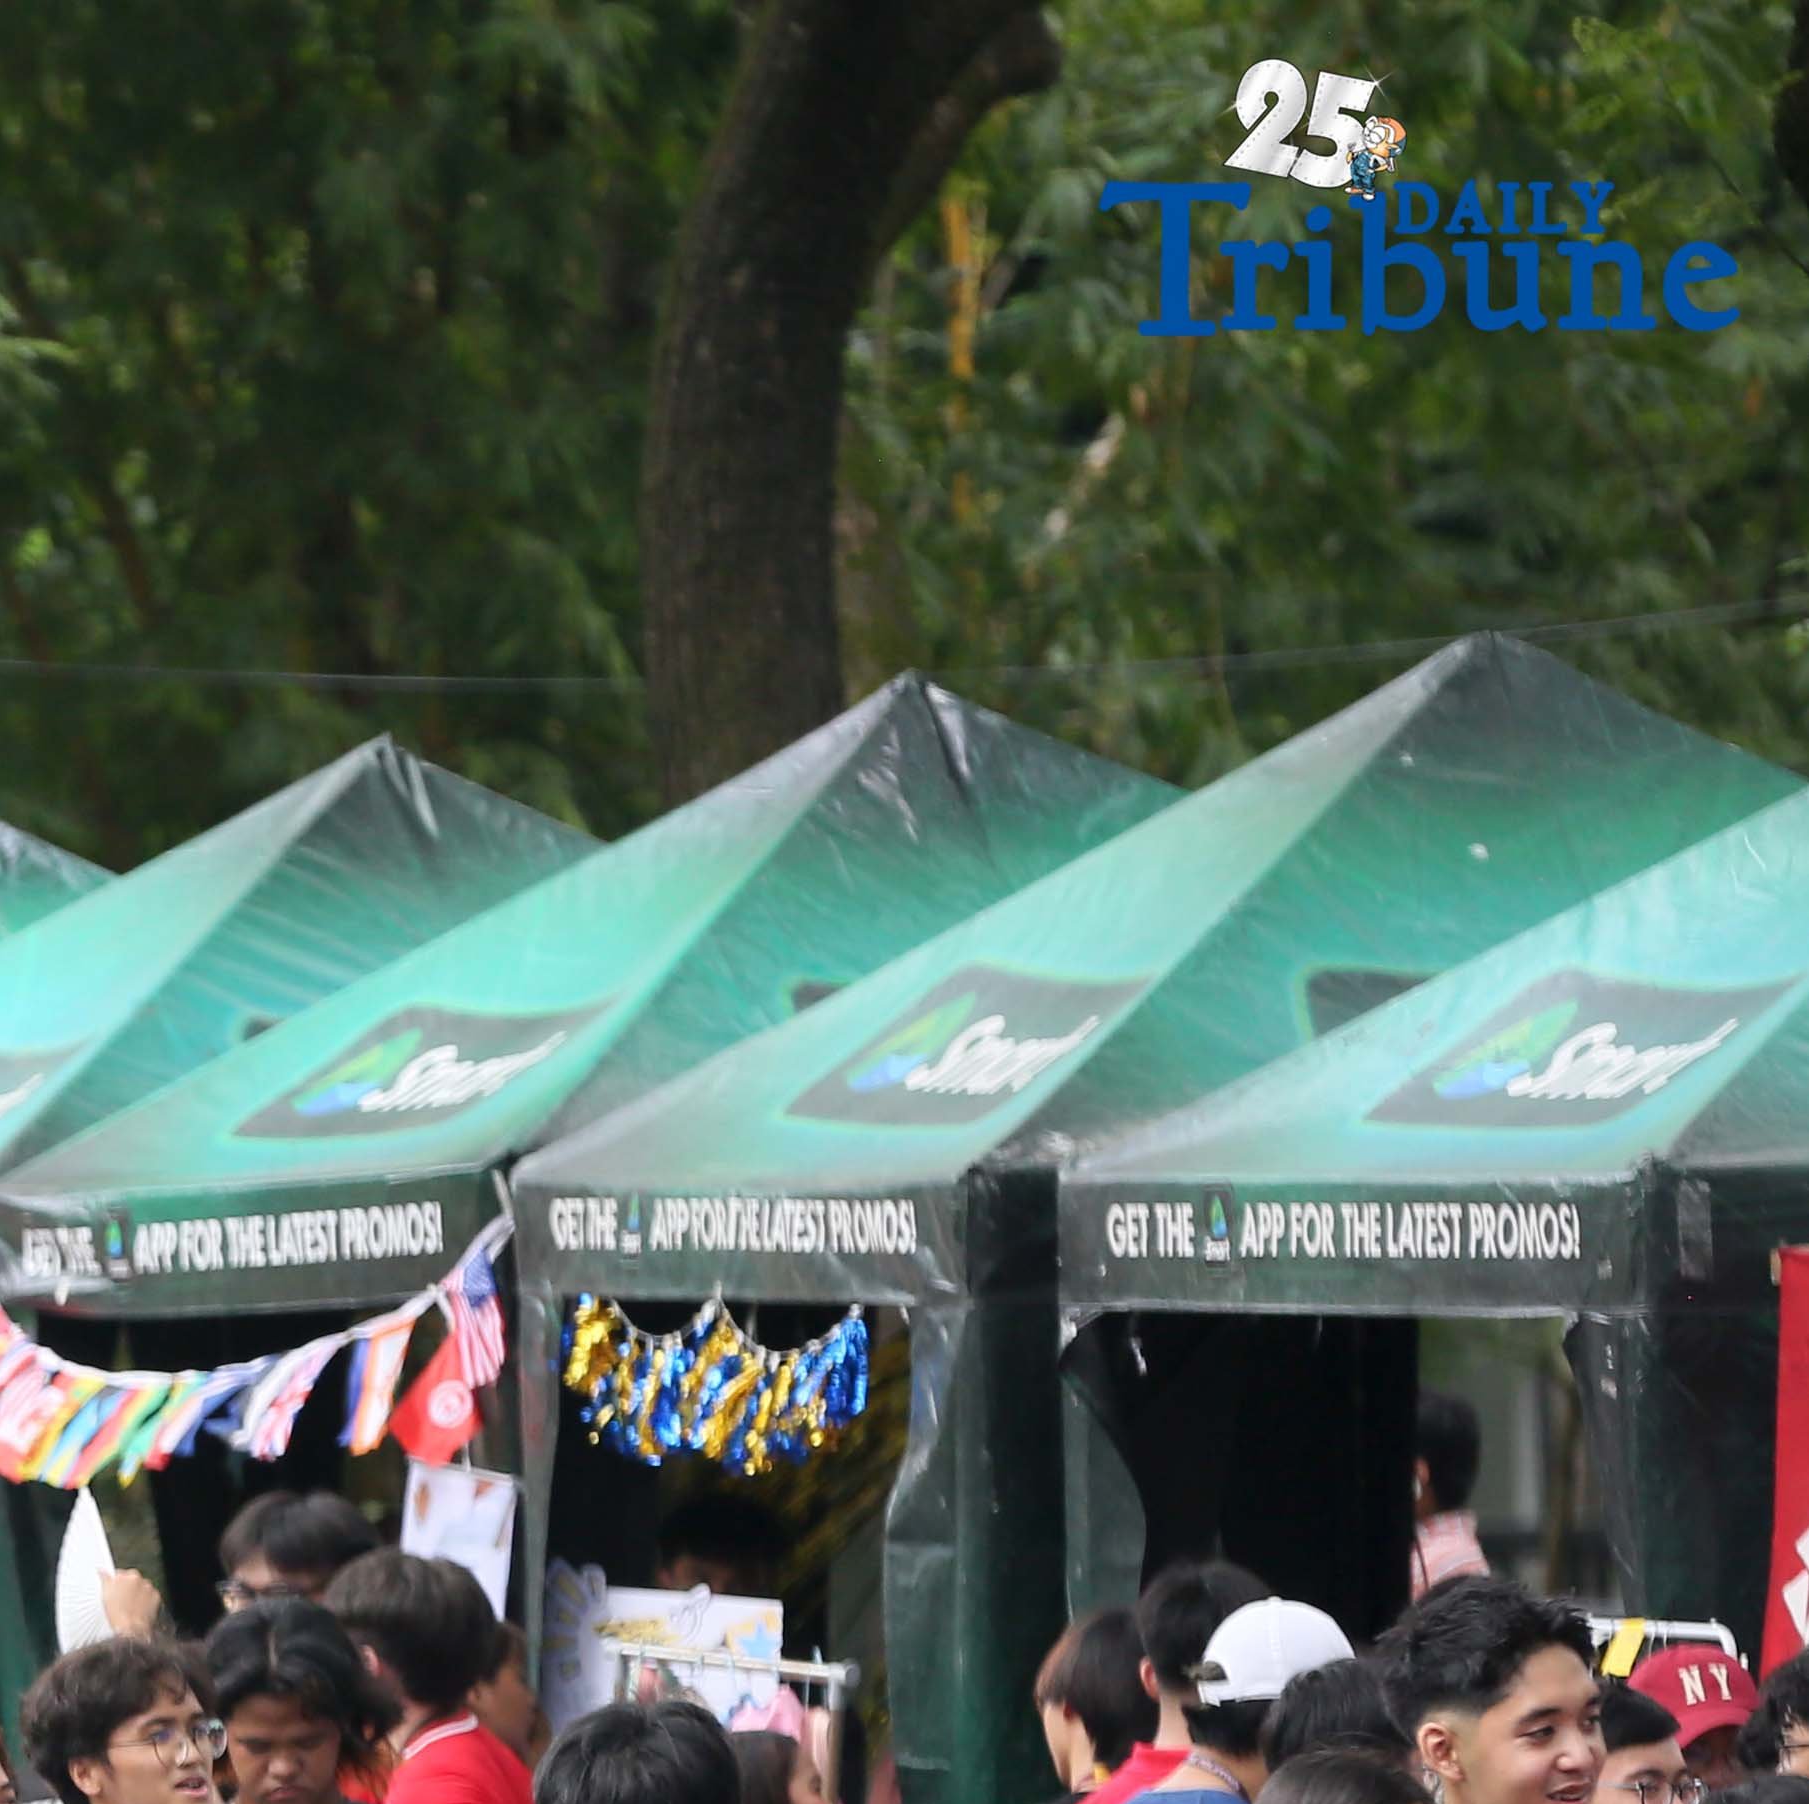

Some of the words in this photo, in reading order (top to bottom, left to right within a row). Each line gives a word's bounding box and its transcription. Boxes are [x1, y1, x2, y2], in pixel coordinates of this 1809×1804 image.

[134, 1222, 177, 1274] APP
[179, 1218, 223, 1272] FOR
[224, 1215, 266, 1269] THE
[266, 1209, 337, 1266] LATEST
[339, 1201, 443, 1260] PROMOS!
[549, 1197, 585, 1251] GET
[586, 1197, 618, 1251] THE
[648, 1197, 689, 1251] APP
[689, 1198, 727, 1251] FOR
[727, 1196, 760, 1251] THE
[761, 1199, 826, 1253] LATEST
[828, 1199, 916, 1254] PROMOS!
[1106, 1202, 1149, 1259] GET
[1154, 1202, 1195, 1258] THE
[1240, 1202, 1285, 1259] APP
[1289, 1202, 1336, 1259] FOR
[1341, 1202, 1381, 1259] THE
[1386, 1202, 1462, 1259] LATEST
[1468, 1203, 1581, 1259] PROMOS!
